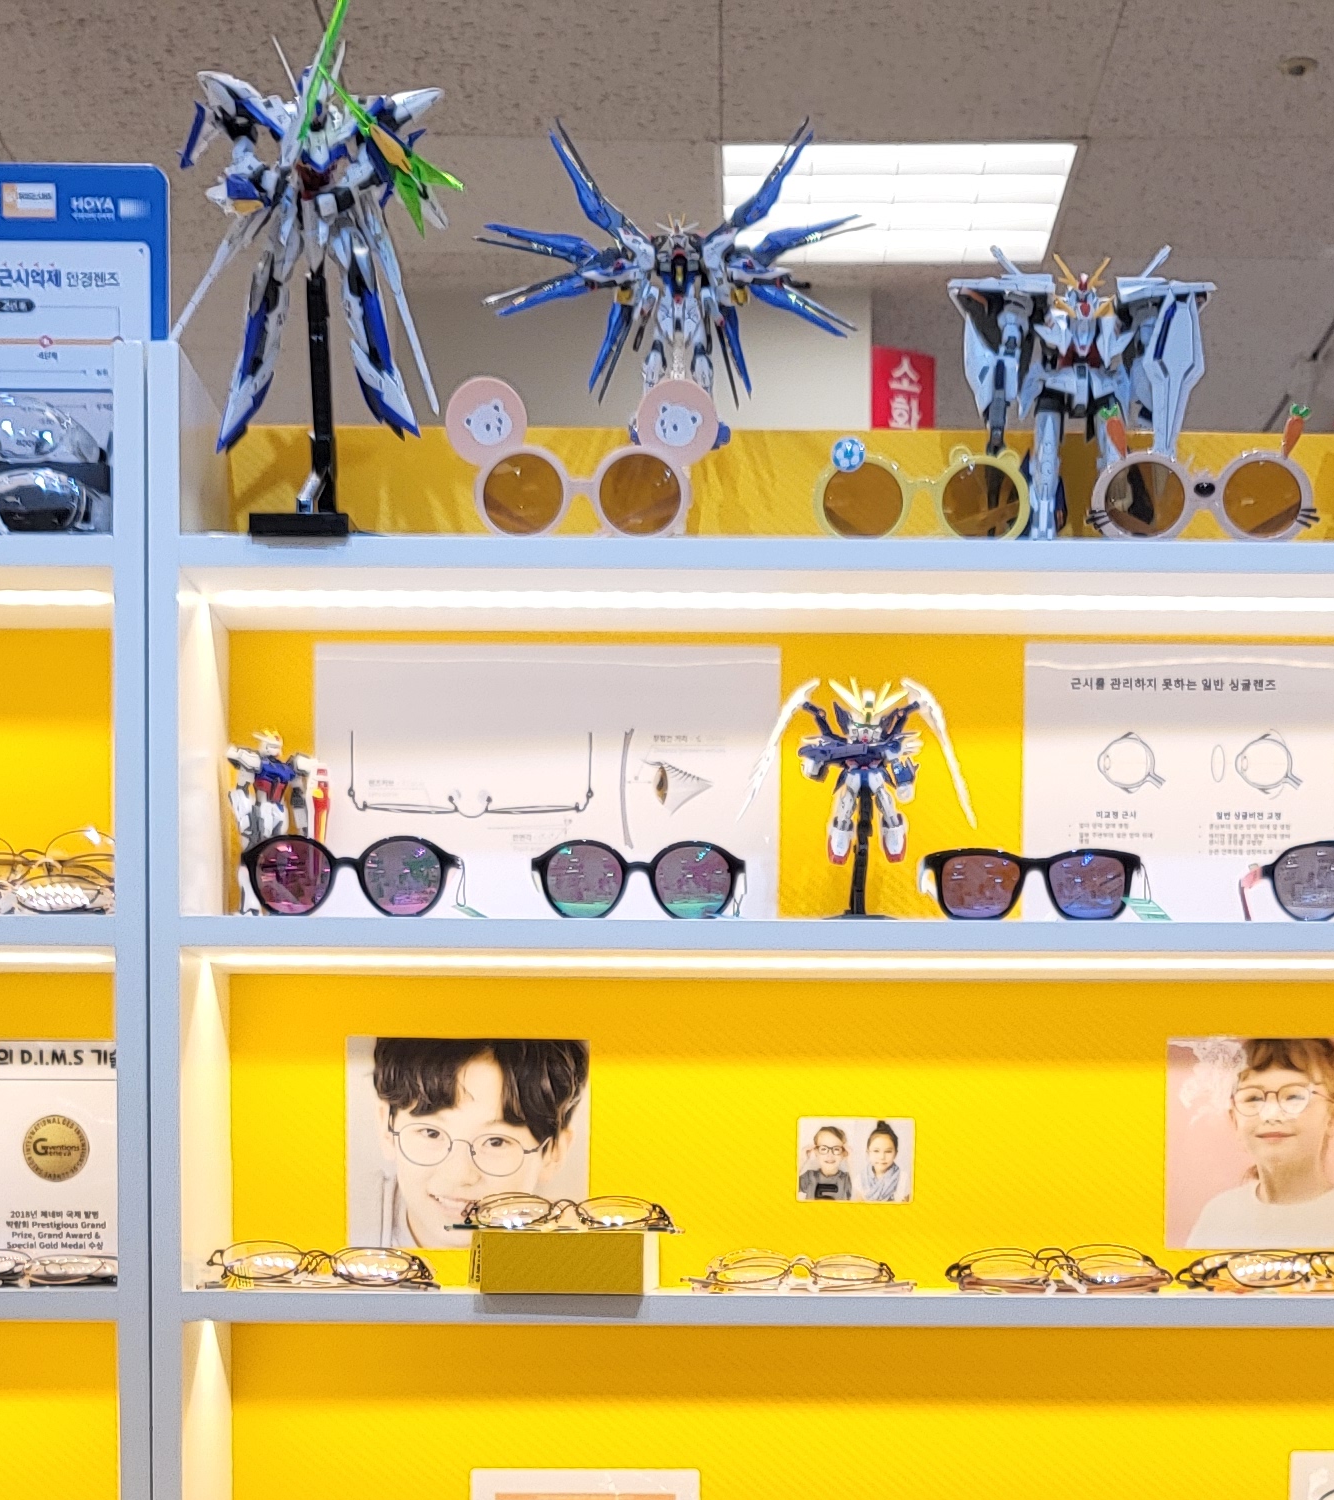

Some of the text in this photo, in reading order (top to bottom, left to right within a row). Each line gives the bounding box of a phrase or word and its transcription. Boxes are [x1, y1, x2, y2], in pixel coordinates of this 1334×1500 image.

[70, 197, 115, 212] HOYA
[1071, 677, 1276, 692] 근시를 관리하지 못하는 일반 싱글렌즈
[20, 1049, 84, 1066] D.I.M.S
[31, 1221, 106, 1230] Prestigious Grand
[11, 1231, 92, 1240] Prize, Grand Award
[6, 1241, 37, 1250] Special
[39, 1241, 58, 1249] Gold
[61, 1241, 86, 1249] Medal
